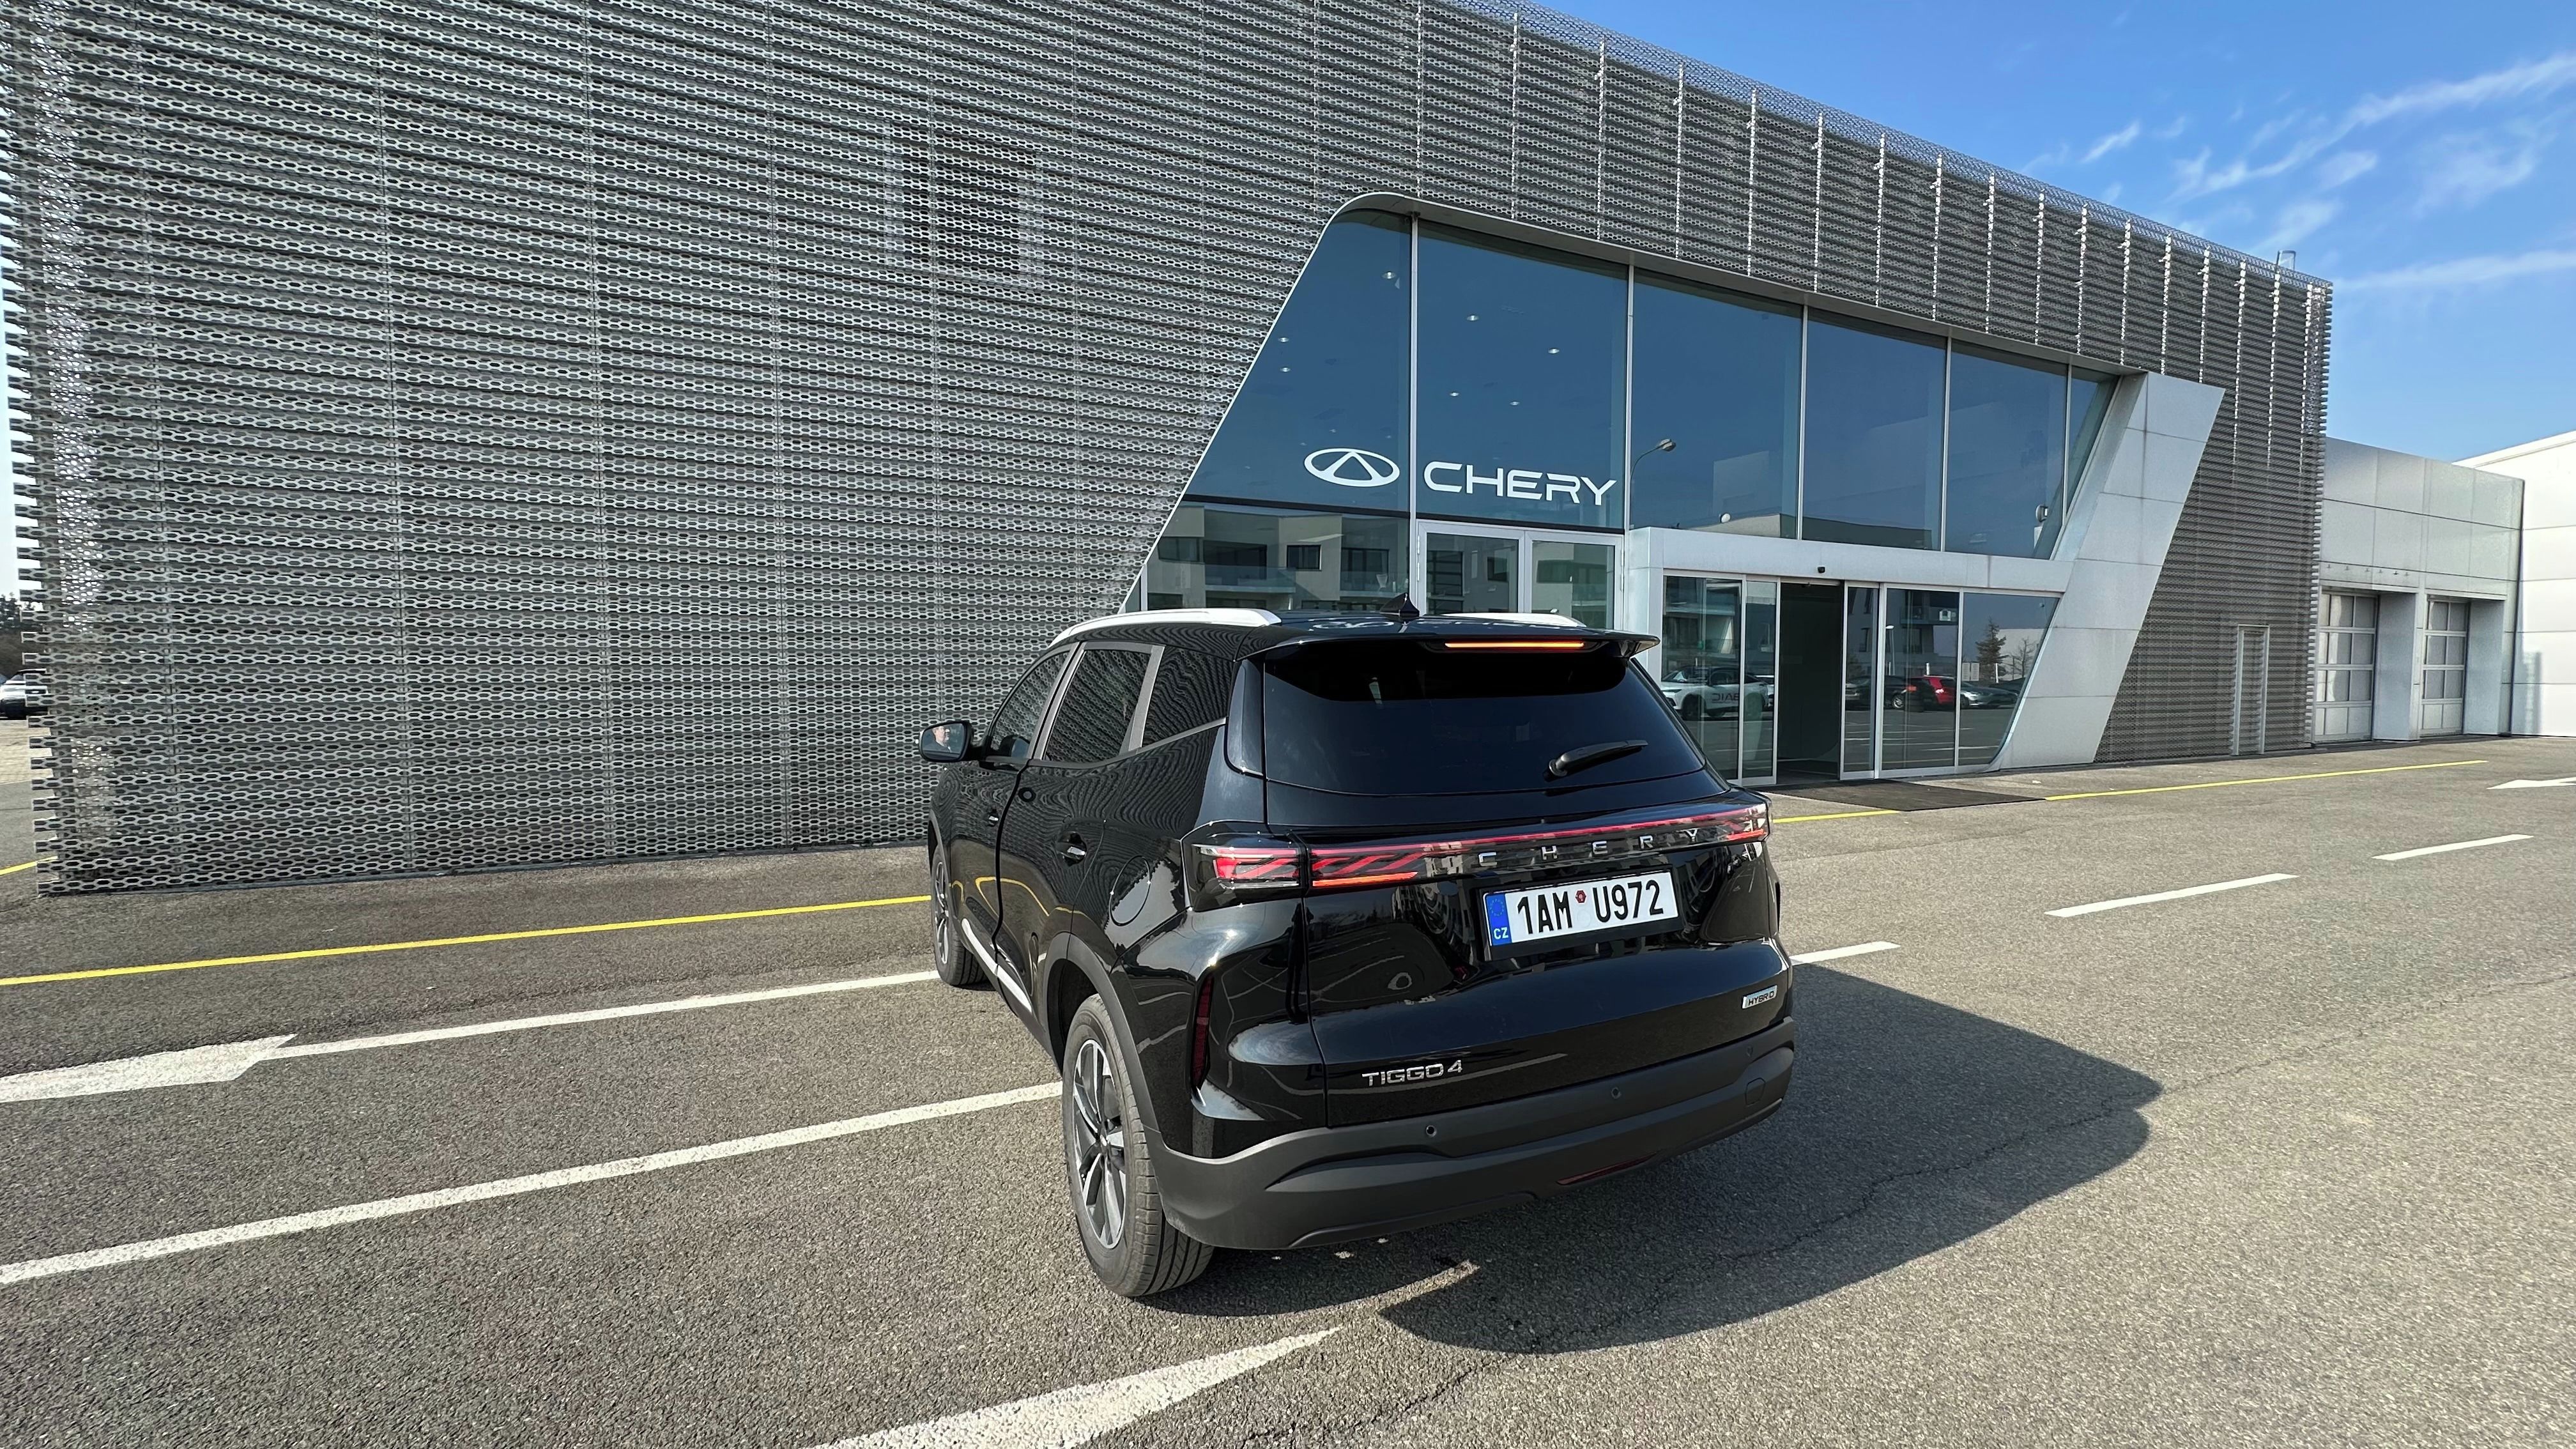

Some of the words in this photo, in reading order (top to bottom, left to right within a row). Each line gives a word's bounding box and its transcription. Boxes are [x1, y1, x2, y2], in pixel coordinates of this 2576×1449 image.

[1424, 461, 1617, 505] CHERY
[1478, 829, 1698, 866] CHERY
[1517, 891, 1572, 934] 1AM
[1593, 880, 1664, 923] U972
[1494, 927, 1508, 939] CZ
[1749, 991, 1774, 1005] HYBRD
[1362, 1063, 1444, 1086] TIGGO
[1448, 1060, 1462, 1073] 4
